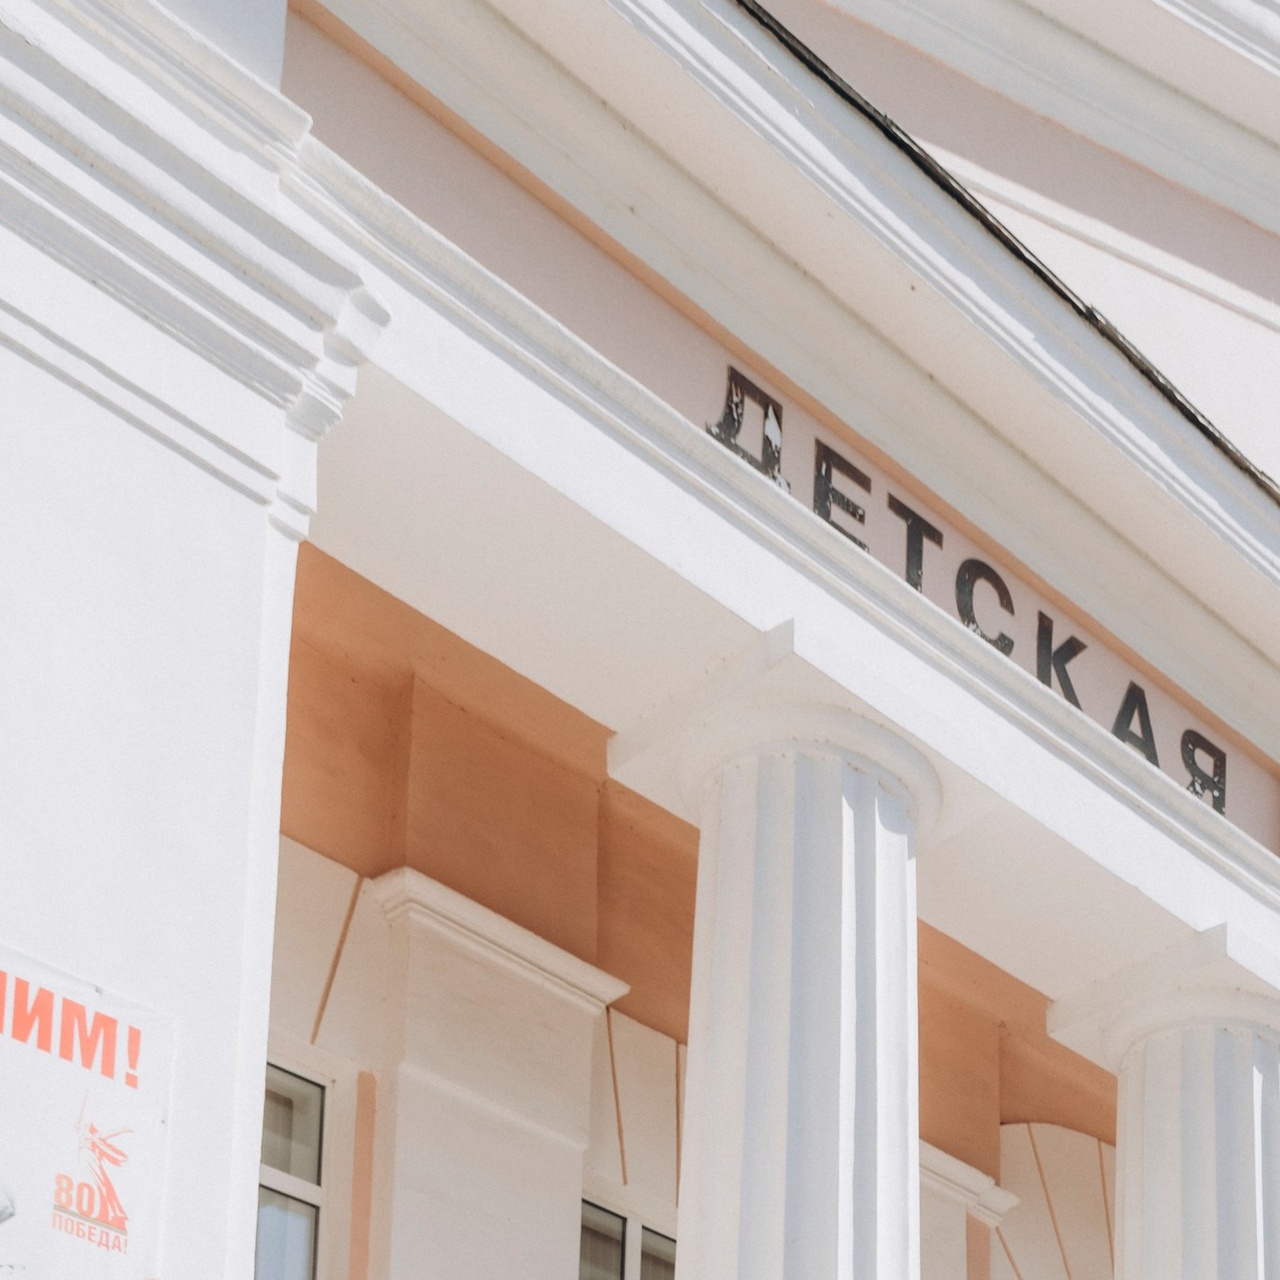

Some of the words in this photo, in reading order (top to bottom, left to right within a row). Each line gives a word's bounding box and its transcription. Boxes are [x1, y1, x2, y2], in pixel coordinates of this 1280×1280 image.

[705, 365, 1227, 816] ДЕТСКАЯ
[0, 969, 141, 1090] ИМ!
[51, 1211, 129, 1256] ПОБЕДА!
